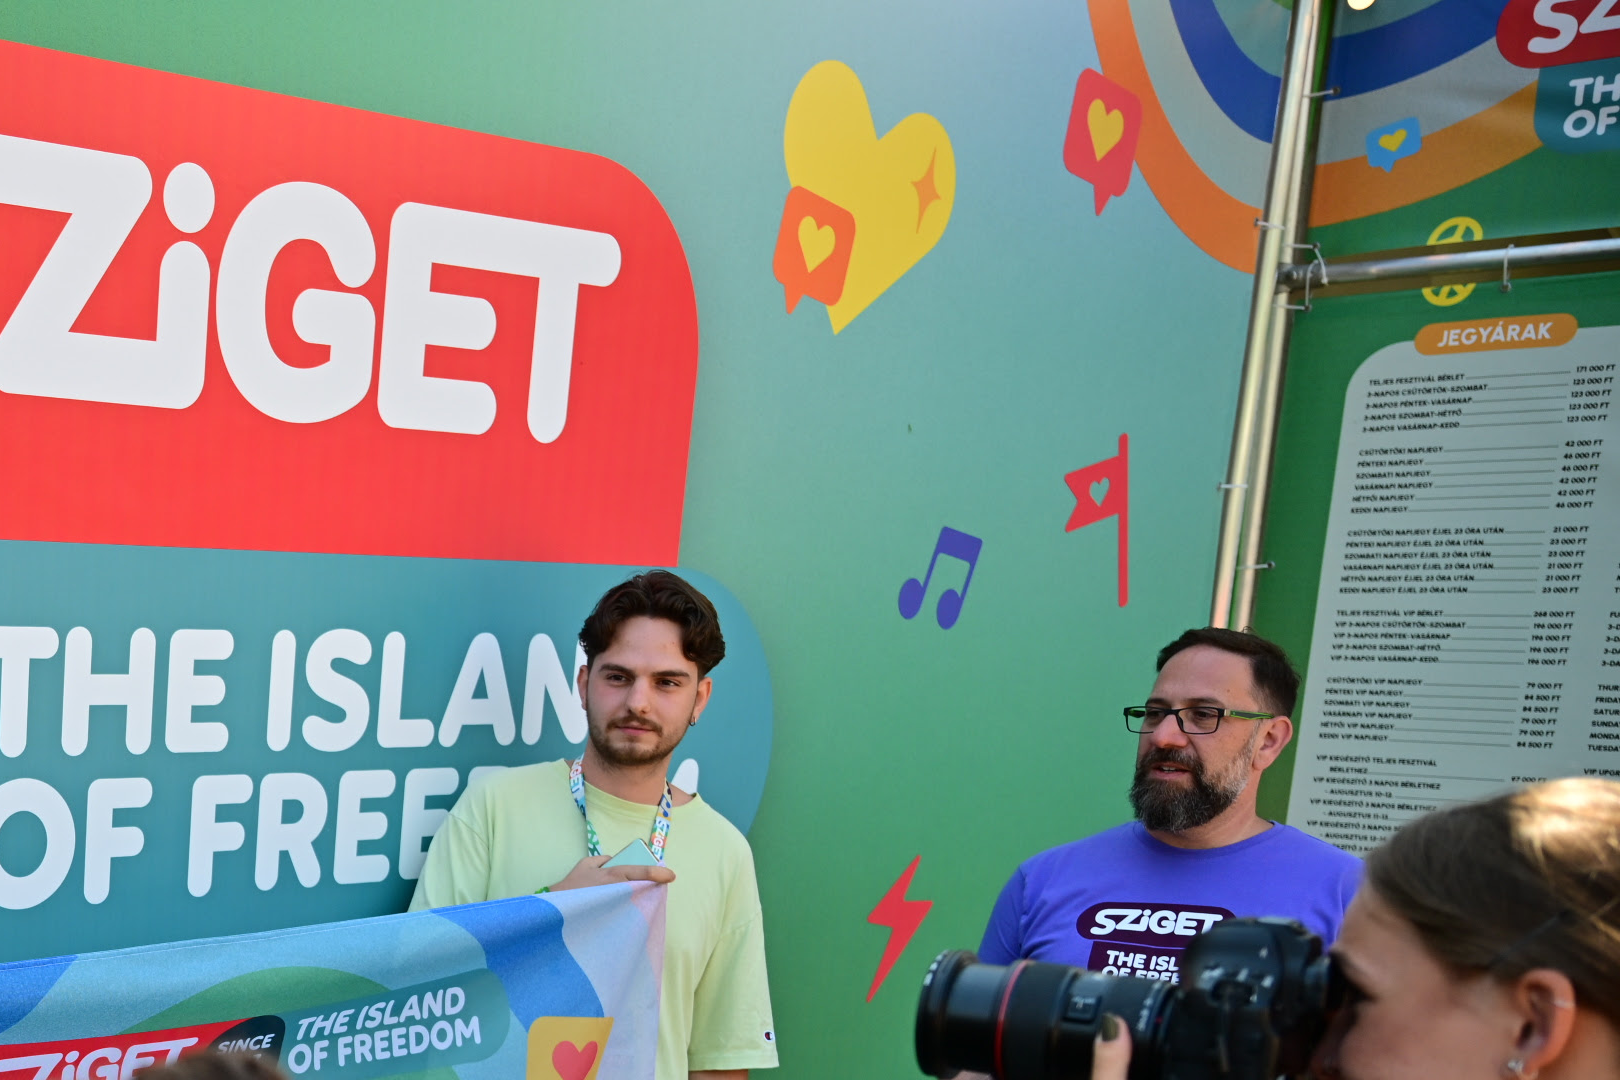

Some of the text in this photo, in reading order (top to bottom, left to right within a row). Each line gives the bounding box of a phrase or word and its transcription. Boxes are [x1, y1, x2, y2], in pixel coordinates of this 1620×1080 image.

[1563, 105, 1620, 138] OF
[1437, 321, 1553, 347] JEGYÁRAK
[266, 629, 585, 752] ISLAN
[1583, 768, 1597, 776] VIP
[1107, 950, 1179, 971] THE ISL
[296, 986, 466, 1041] THE ISLAND
[218, 1033, 276, 1054] SINCE
[287, 1014, 482, 1074] OF FREEDOM
